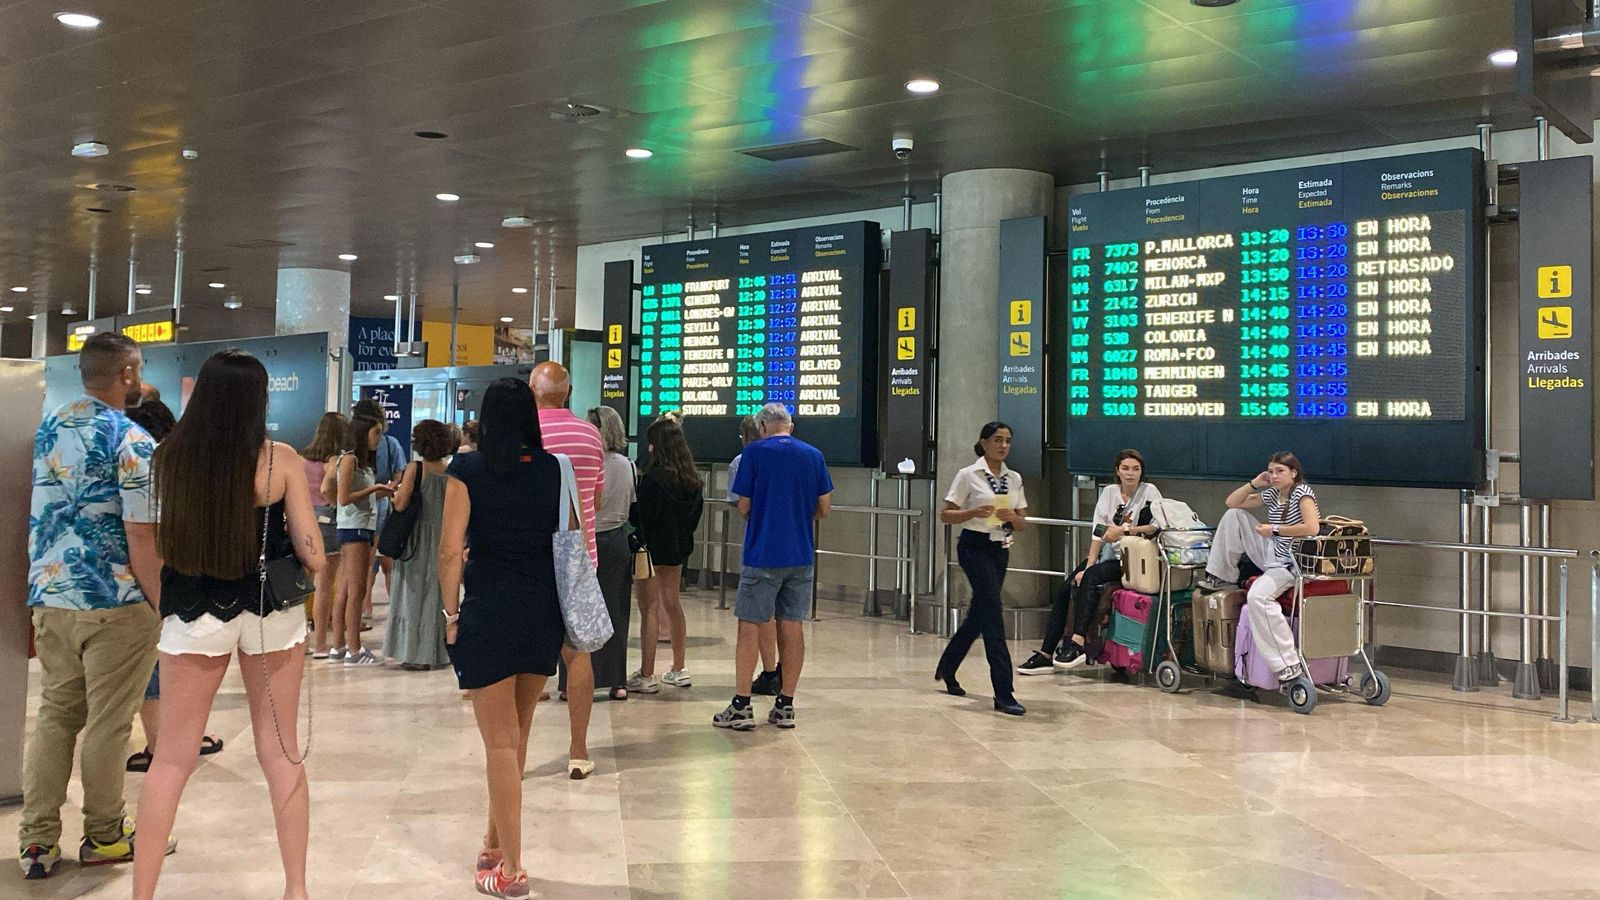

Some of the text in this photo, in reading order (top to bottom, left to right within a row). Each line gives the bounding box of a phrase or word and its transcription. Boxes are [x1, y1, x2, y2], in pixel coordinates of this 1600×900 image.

[1381, 170, 1434, 182] Observacions
[1298, 179, 1332, 188] Estimada
[1381, 181, 1412, 190] Remarks
[1242, 187, 1259, 195] Hora
[1298, 189, 1327, 199] Expected
[1381, 188, 1439, 201] Observaciones
[1242, 196, 1257, 204] Time
[1298, 199, 1332, 208] Estimada
[1242, 206, 1259, 214] Hora
[1071, 216, 1087, 225] Flight
[1146, 214, 1185, 224] Procedencia
[1072, 224, 1088, 232] Vuelo
[1072, 248, 1090, 260] FR
[1104, 243, 1138, 257] 7373
[1146, 234, 1233, 255] P.MALLORCA
[1240, 229, 1290, 246] 13:20
[1357, 220, 1378, 236] EN
[1387, 216, 1432, 235] HORA
[1072, 236, 1432, 277] FR 7402 MENORCA 13:20 13:20 EN HORA
[770, 274, 796, 285] 12:51
[802, 270, 842, 283] ARRIVAL
[1104, 279, 1138, 292] 6317
[1145, 272, 1225, 290] MILAN-MXP
[1240, 268, 1290, 284] 13:50
[1298, 264, 1348, 280] 14:20
[1357, 255, 1453, 277] RETRASADO
[801, 284, 842, 298] ARRIVAL
[1072, 277, 1432, 312] LX 2142 ZURICH 14:15 14:20 EN HORA
[769, 302, 796, 314] 12:27
[801, 299, 842, 312] ARRIVAL
[1072, 317, 1090, 329] VY
[1145, 311, 1215, 326] TENERIFE
[1222, 309, 1234, 323] N
[1240, 306, 1290, 322] 14:40
[1298, 304, 1348, 318] 14:20
[1357, 301, 1378, 316] EN
[1387, 298, 1432, 316] HORA
[684, 322, 720, 334] SEVILLA
[769, 317, 796, 328] 12:52
[801, 314, 841, 327] ARRIVAL
[358, 326, 395, 343] A plac
[769, 332, 796, 342] 12:47
[801, 329, 841, 342] ARRIVAL
[1144, 328, 1207, 344] COLONIA
[1240, 325, 1290, 340] 14:40
[1298, 323, 1348, 338] 14:50
[1357, 321, 1378, 336] EN
[1387, 318, 1432, 336] HORA
[358, 341, 376, 356] for
[684, 350, 723, 360] TENERIFE
[800, 344, 841, 357] ARRIVAL
[1144, 347, 1215, 362] ROMA-FCO
[1240, 345, 1290, 359] 14:40
[1298, 343, 1348, 358] 14:45
[1357, 342, 1378, 356] EN
[1387, 339, 1432, 356] HORA
[1527, 351, 1579, 360] Arribades
[800, 359, 840, 371] DELAYED
[1003, 365, 1035, 373] Arribades
[1527, 364, 1568, 373] Arrivals
[1072, 368, 1090, 381] FR
[1144, 365, 1225, 379] MEMMINGEN
[1240, 364, 1290, 378] 14:45
[1298, 363, 1348, 377] 14:45
[800, 374, 840, 386] ARRIVAL
[892, 377, 912, 385] Arrivals
[1528, 377, 1584, 390] Llegadas
[800, 389, 840, 401] ARRIVAL
[892, 387, 920, 396] Llegadas
[1004, 385, 1037, 395] Llegadas
[1072, 386, 1090, 398] FR
[1144, 384, 1197, 398] TANGER
[1240, 383, 1290, 397] 14:55
[1298, 383, 1348, 396] 14:55
[800, 404, 840, 416] DELAYED
[1104, 403, 1138, 416] 5101
[1144, 402, 1225, 416] EINDHOVEN
[1240, 402, 1290, 416] 15:05
[1298, 402, 1348, 416] 14:50
[1357, 402, 1378, 416] EN
[1387, 400, 1432, 416] HORA
